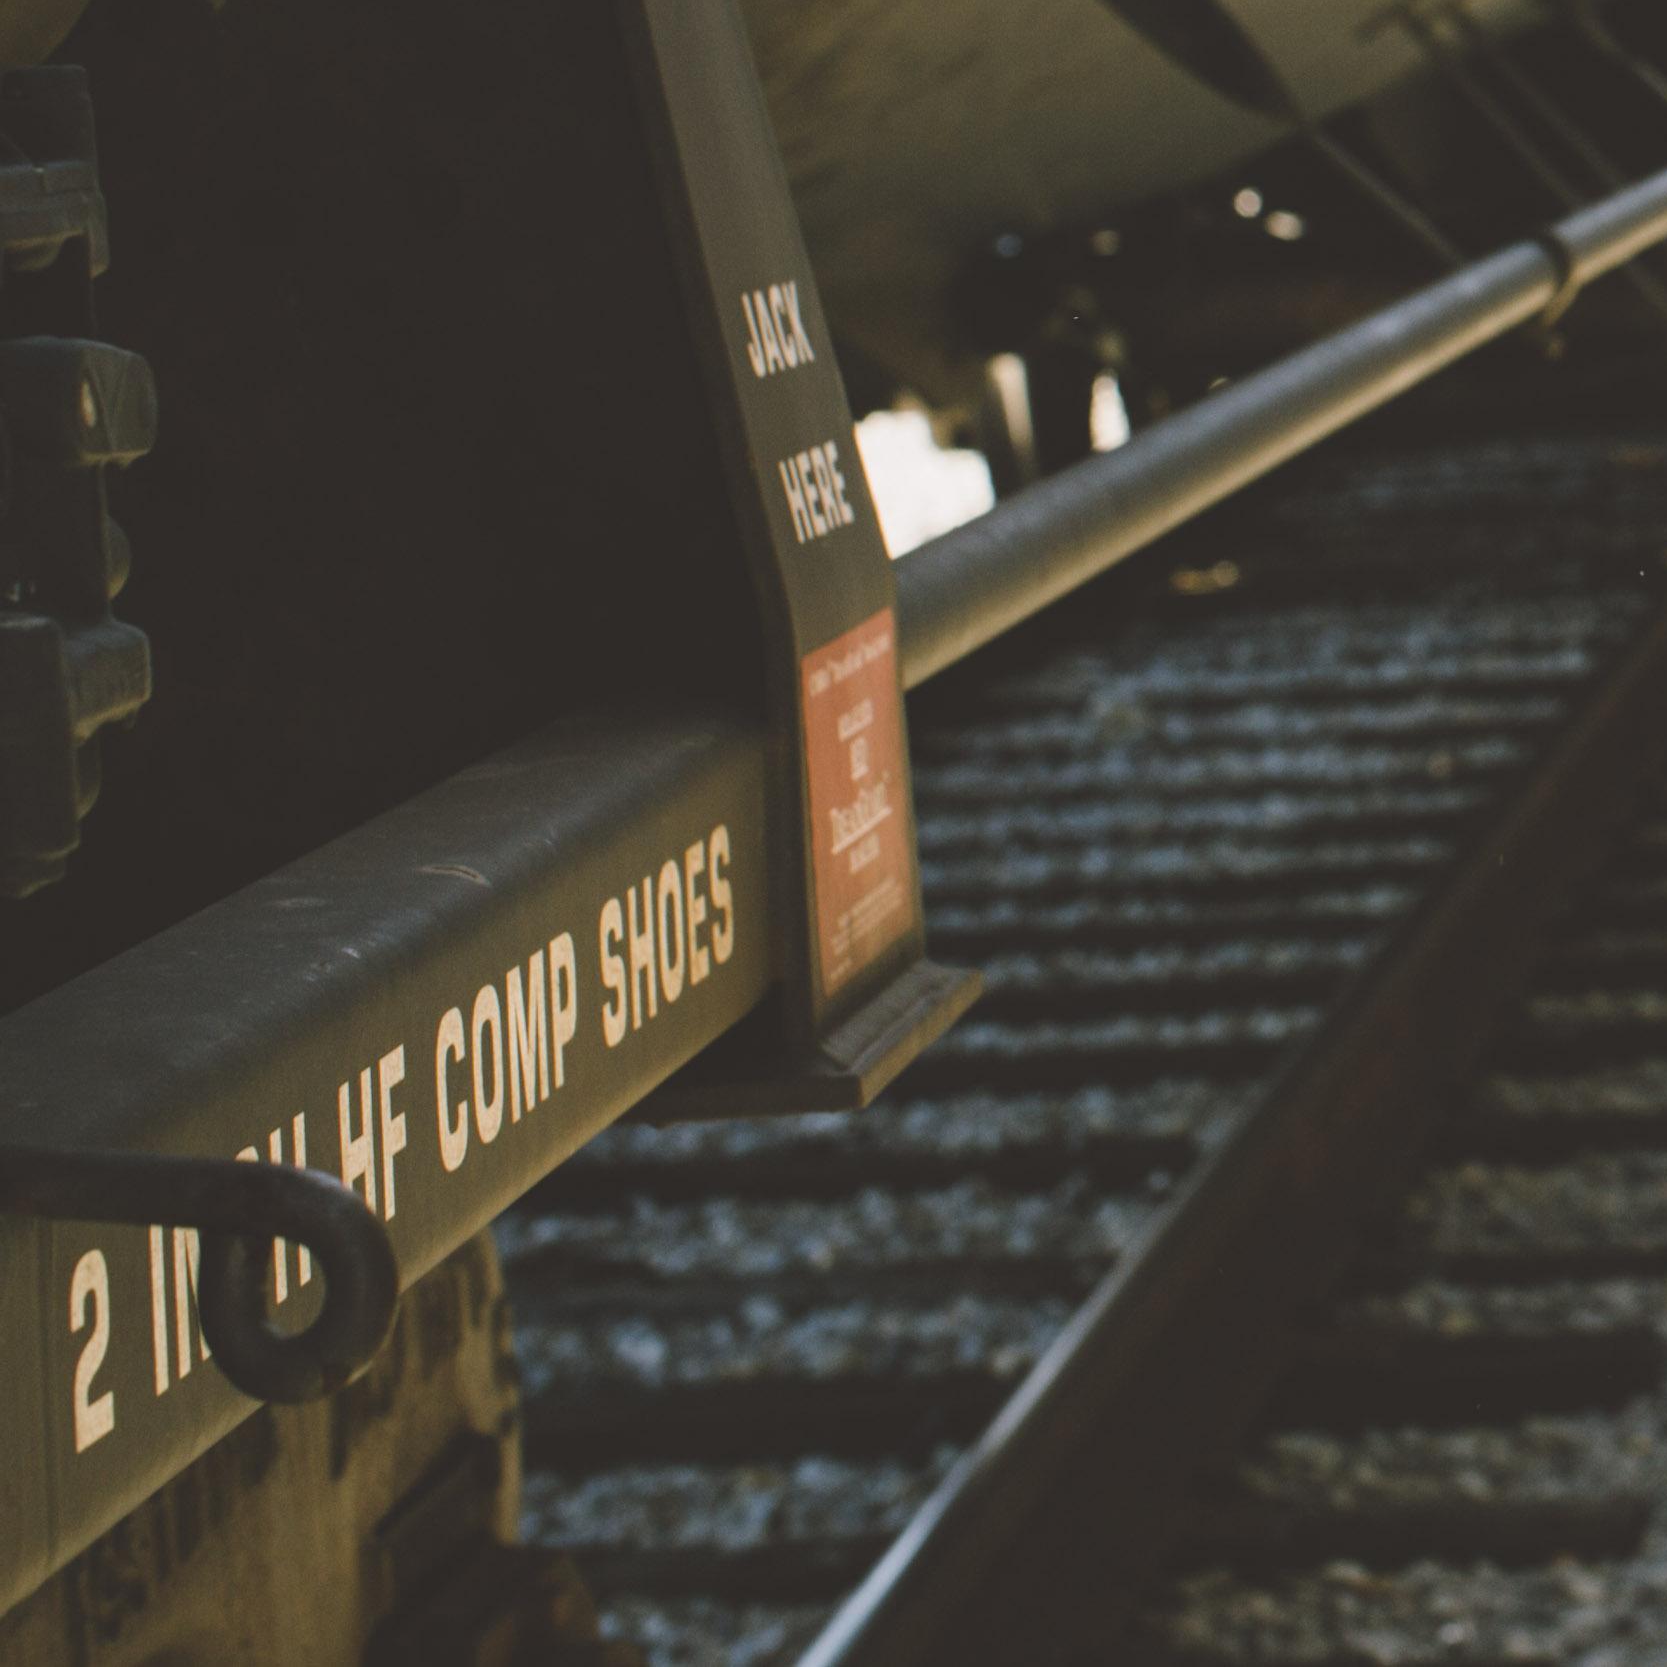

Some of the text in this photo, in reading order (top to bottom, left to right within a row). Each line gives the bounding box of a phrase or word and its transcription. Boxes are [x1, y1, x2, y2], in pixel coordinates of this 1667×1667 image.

[741, 281, 815, 378] JACK
[779, 439, 854, 544] HERE
[69, 1248, 116, 1454] 2
[337, 1043, 408, 1222] HF
[435, 931, 578, 1173] COMP
[599, 824, 735, 1049] SHOES
